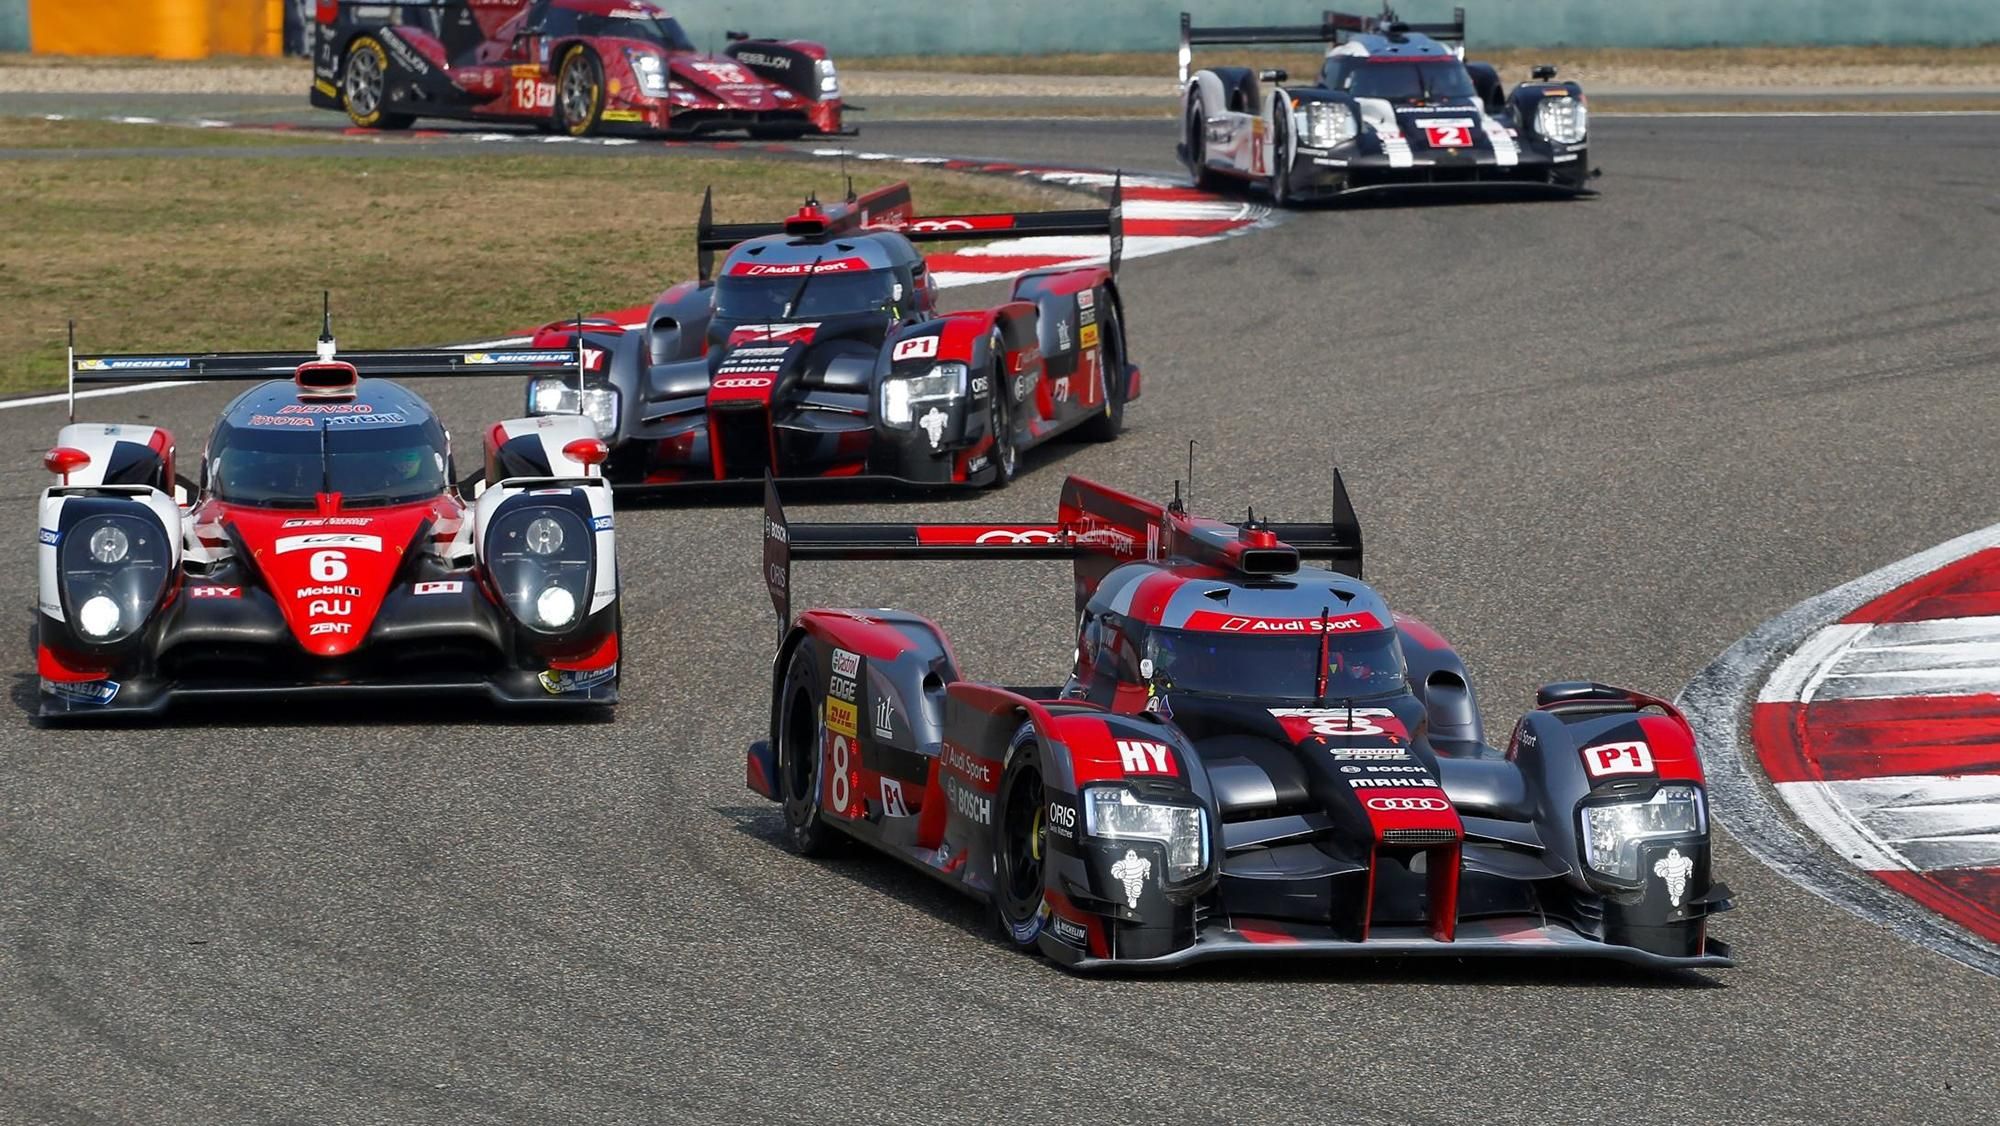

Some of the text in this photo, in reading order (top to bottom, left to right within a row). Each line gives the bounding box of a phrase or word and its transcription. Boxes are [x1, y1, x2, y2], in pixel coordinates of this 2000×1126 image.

[737, 52, 792, 70] REBELLION
[515, 79, 536, 109] 13
[1436, 126, 1463, 146] 2
[764, 261, 848, 274] Audi Sport
[901, 339, 931, 355] P1
[112, 360, 187, 368] MICHELIN
[718, 365, 781, 374] MAHLE
[1086, 349, 1096, 403] 7
[277, 404, 373, 415] DENSO
[248, 414, 315, 427] TOYOTA
[310, 550, 348, 582] 6
[193, 587, 239, 597] HY
[297, 586, 343, 599] Mobil
[421, 583, 455, 593] P1
[309, 622, 352, 635] ZENT
[1252, 618, 1361, 632] Audi Sport
[829, 675, 857, 702] EDGE
[876, 695, 895, 731] itk
[1307, 716, 1385, 736] 8
[949, 747, 990, 783] Audi Sport
[1116, 741, 1168, 773] HY
[1597, 746, 1642, 769] P1
[832, 735, 850, 813] 8
[1348, 778, 1439, 788] MAHLE
[884, 784, 907, 816] P1
[959, 787, 991, 825] BOSCH
[1050, 802, 1076, 828] ORIS
[1060, 924, 1086, 939] MICHELIN
